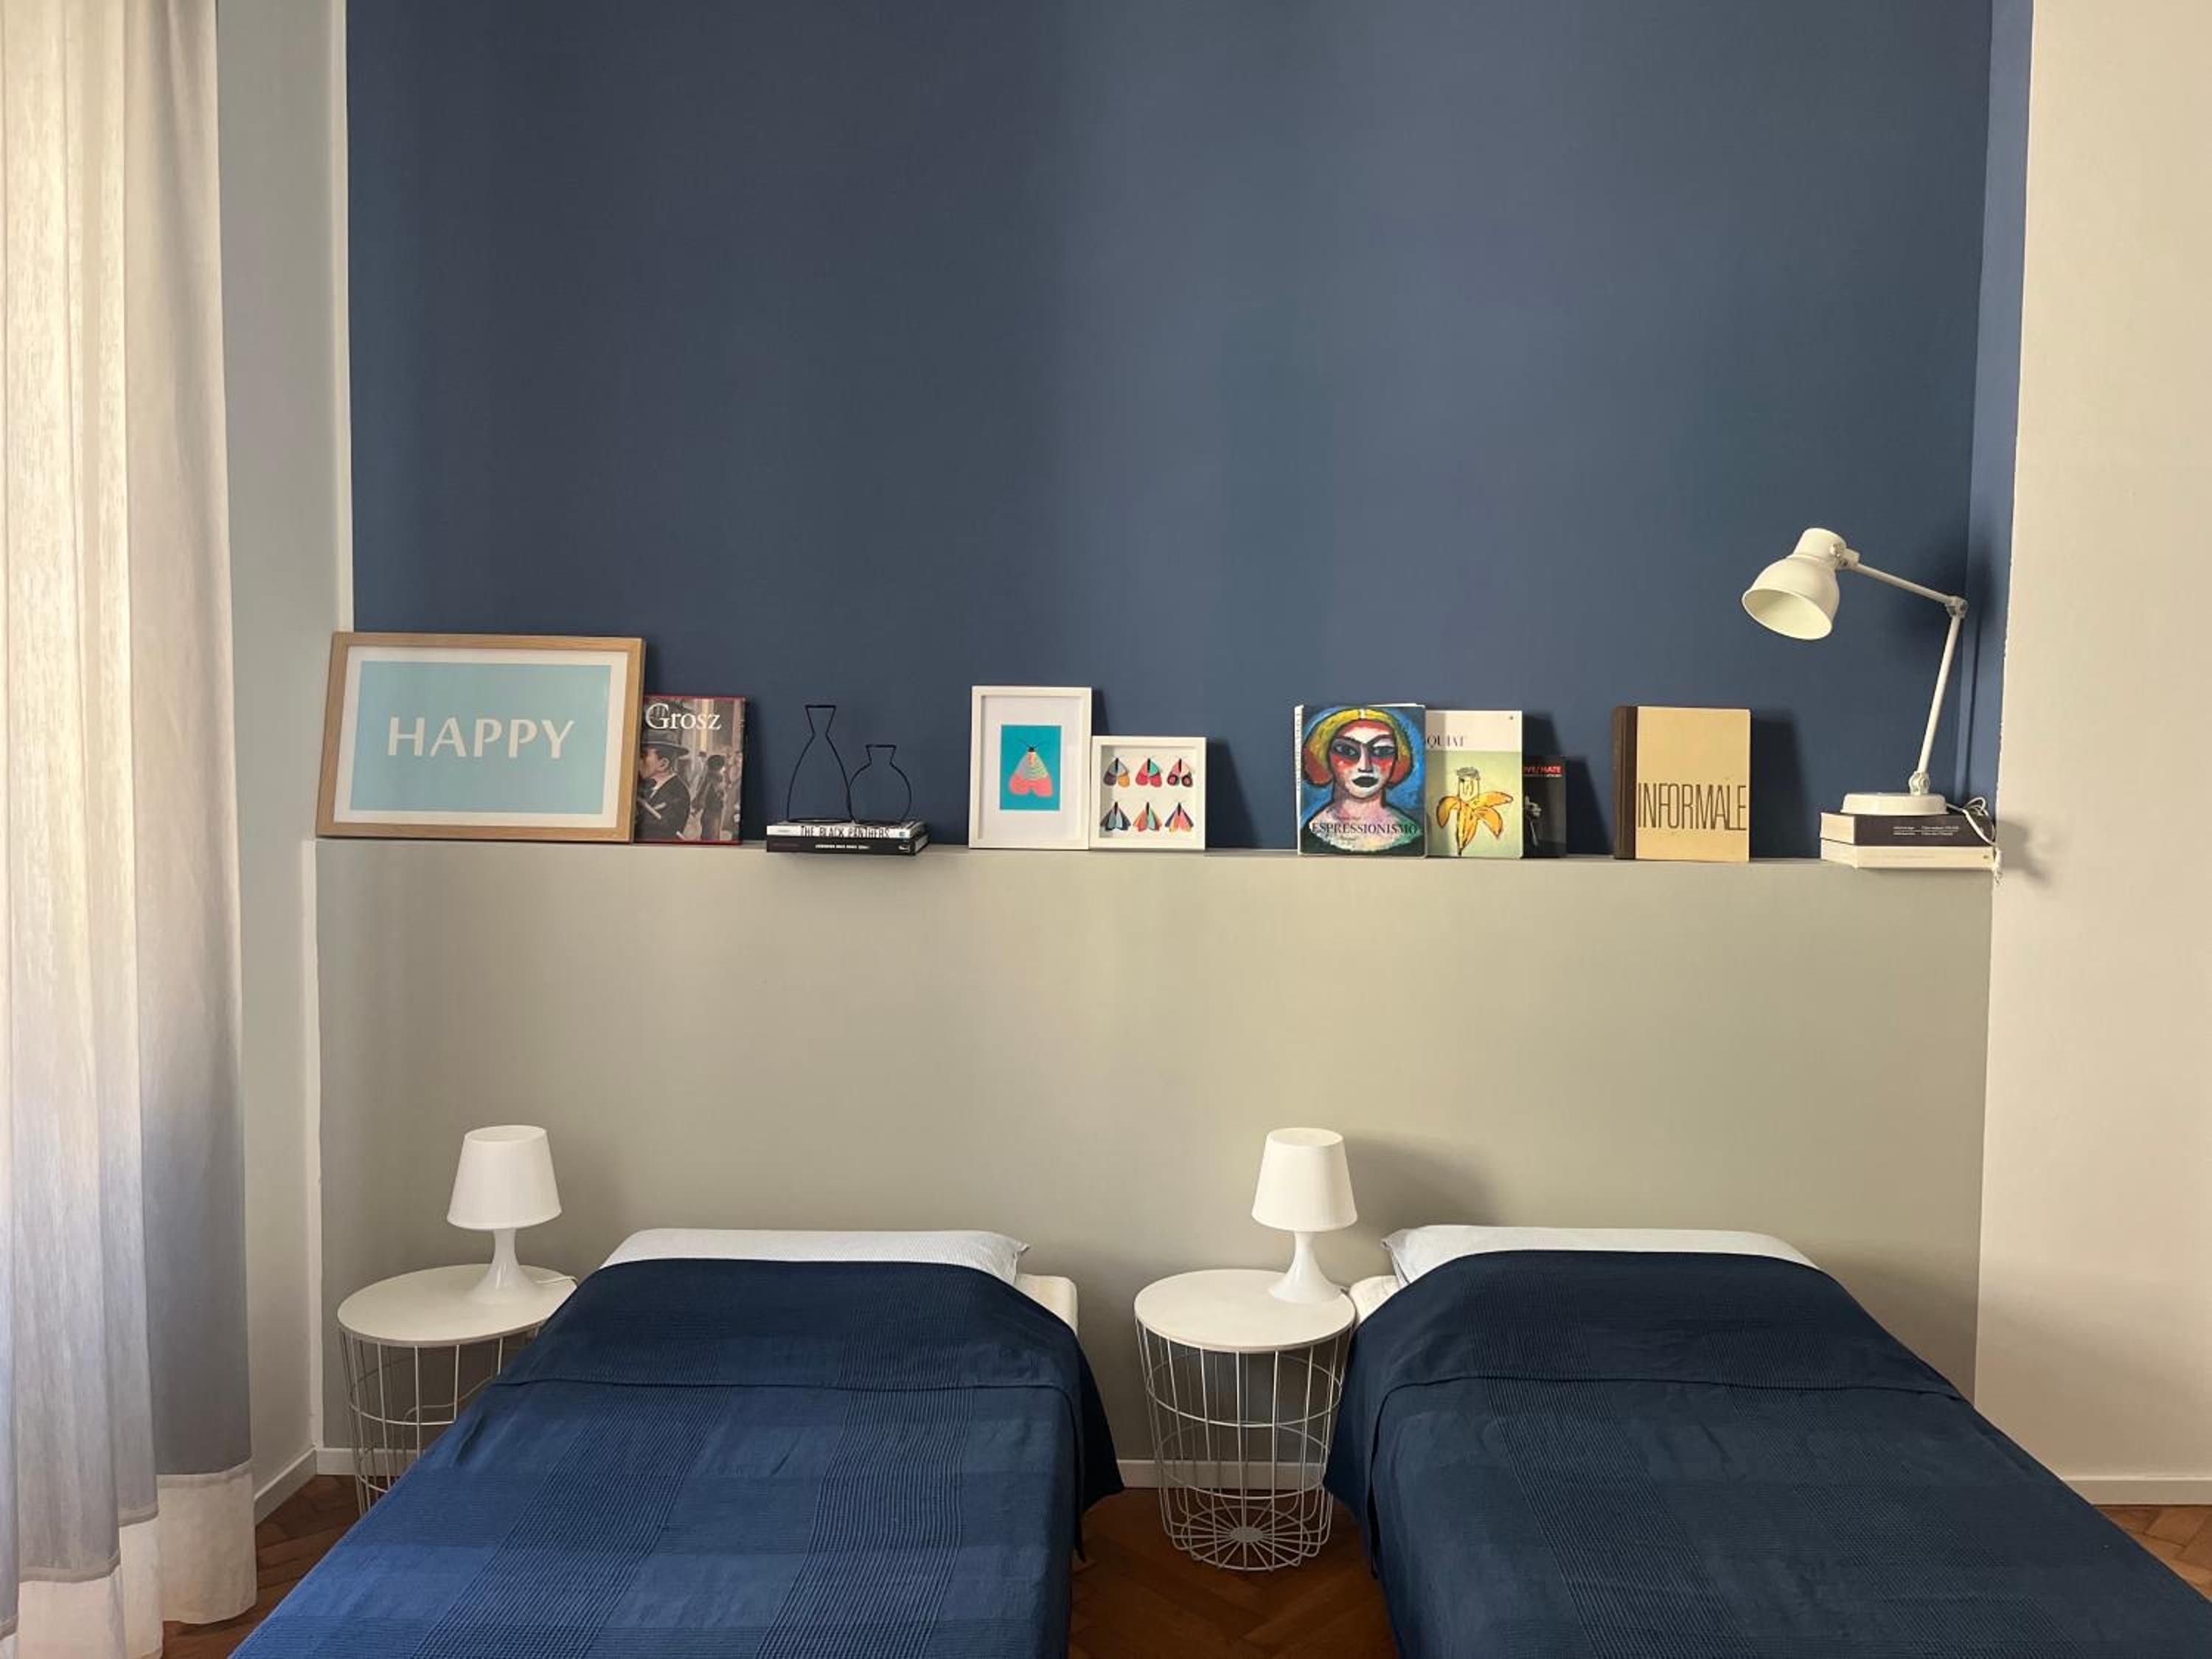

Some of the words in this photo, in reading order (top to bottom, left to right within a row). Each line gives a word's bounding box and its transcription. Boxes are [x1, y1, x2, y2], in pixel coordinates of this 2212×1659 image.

[645, 703, 722, 730] Grosz
[387, 716, 575, 758] HAPPY
[1427, 735, 1464, 747] QUIAT
[1638, 782, 1747, 831] INFORMALE
[801, 825, 814, 837] THE
[819, 826, 844, 838] BLACK
[849, 827, 890, 838] PANTHERS
[1311, 822, 1418, 835] ESPRESSIONISMO
